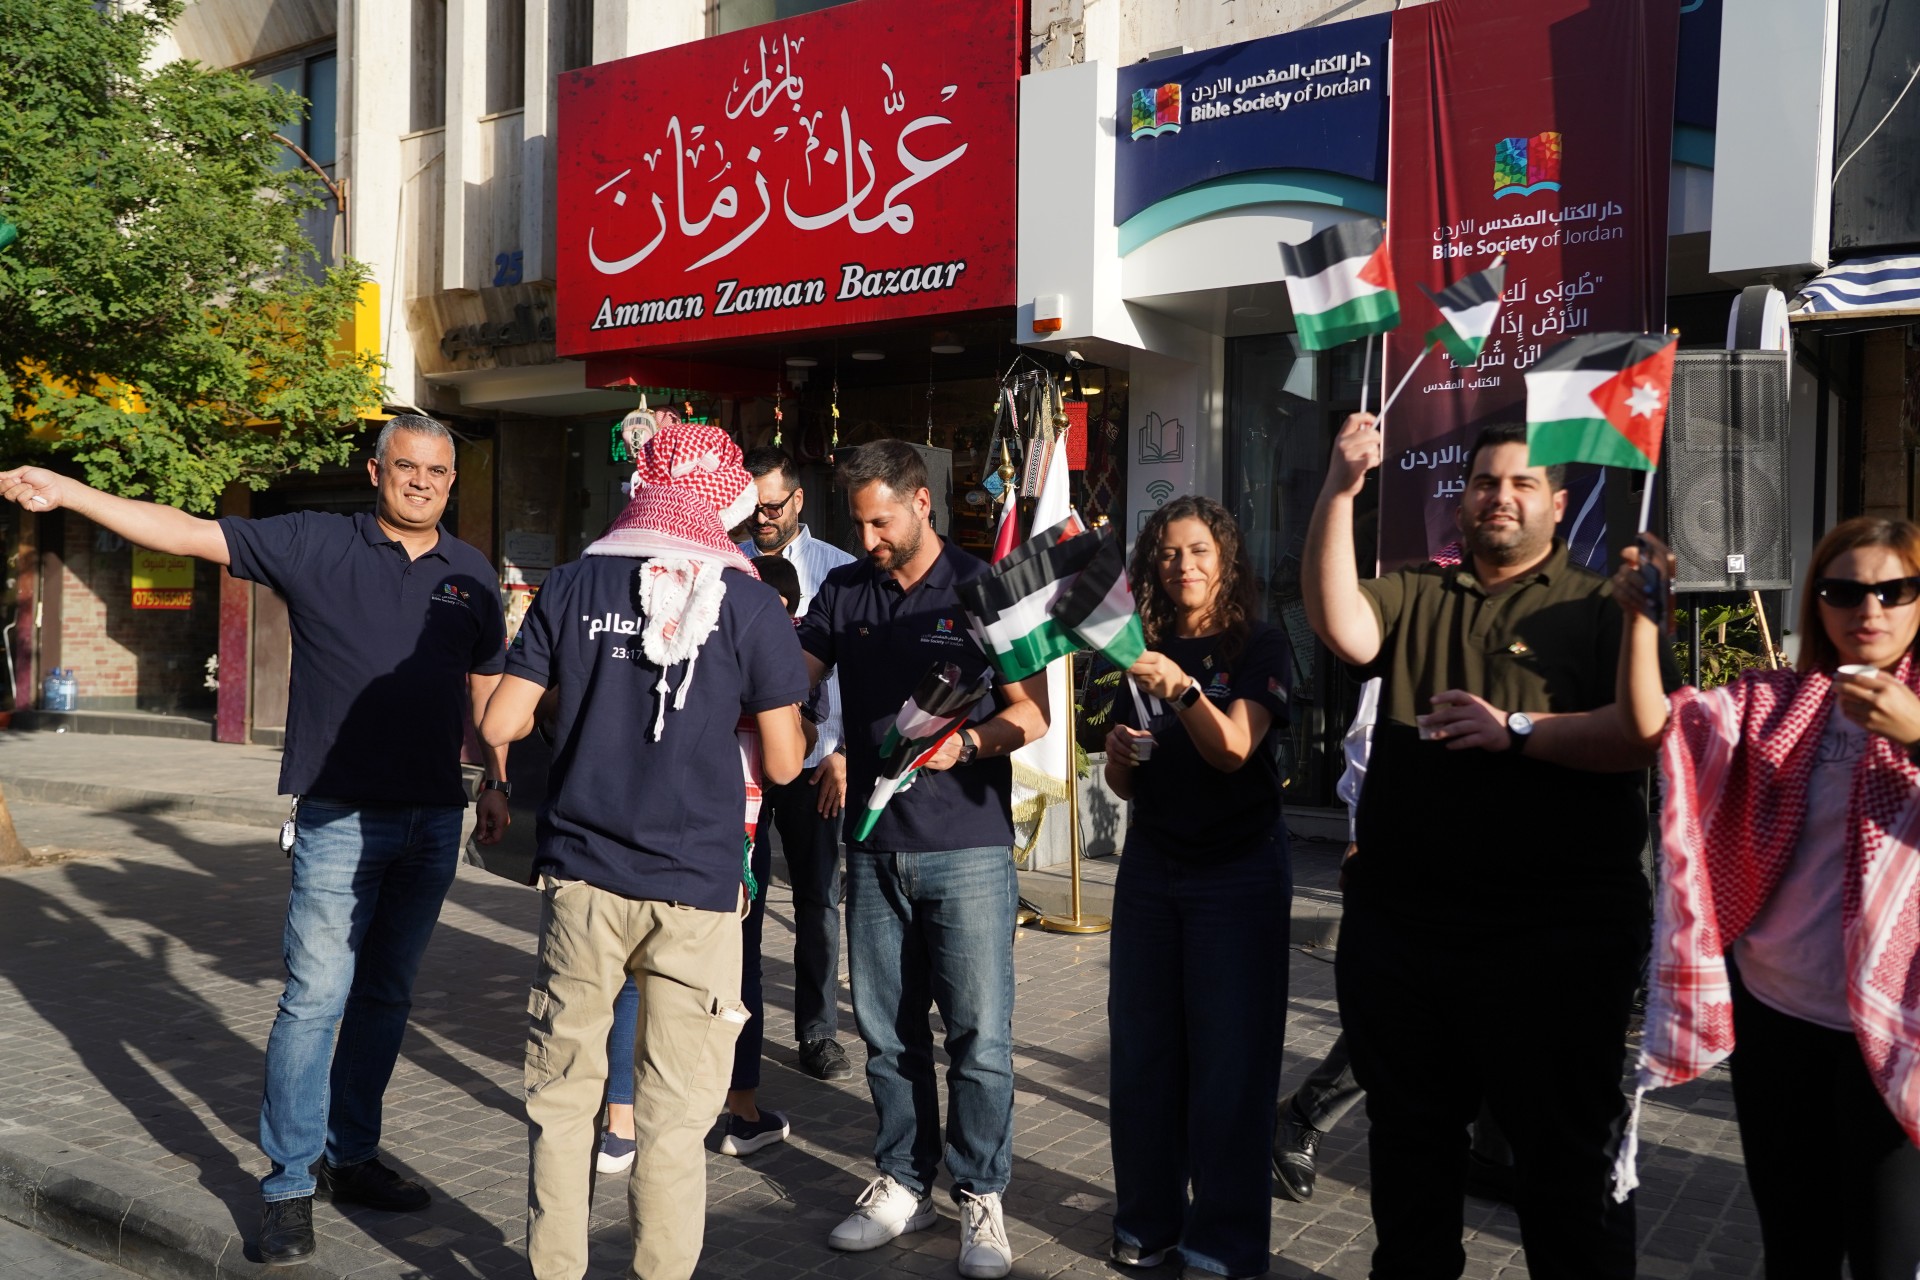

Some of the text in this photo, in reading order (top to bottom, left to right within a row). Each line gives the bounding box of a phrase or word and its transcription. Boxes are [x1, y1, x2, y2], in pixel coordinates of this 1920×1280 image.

[1191, 51, 1371, 102] دار الكتاب المقدس الاردن
[1191, 78, 1370, 122] Bible Society of Jordan
[1433, 201, 1623, 241] دار الكتاب المقدس الاردن
[1432, 224, 1623, 260] Bible Society of Jordan
[493, 250, 524, 288] 25
[591, 260, 967, 330] Amman Zaman Bazaar
[1423, 377, 1500, 393] الكتاب المقدس
